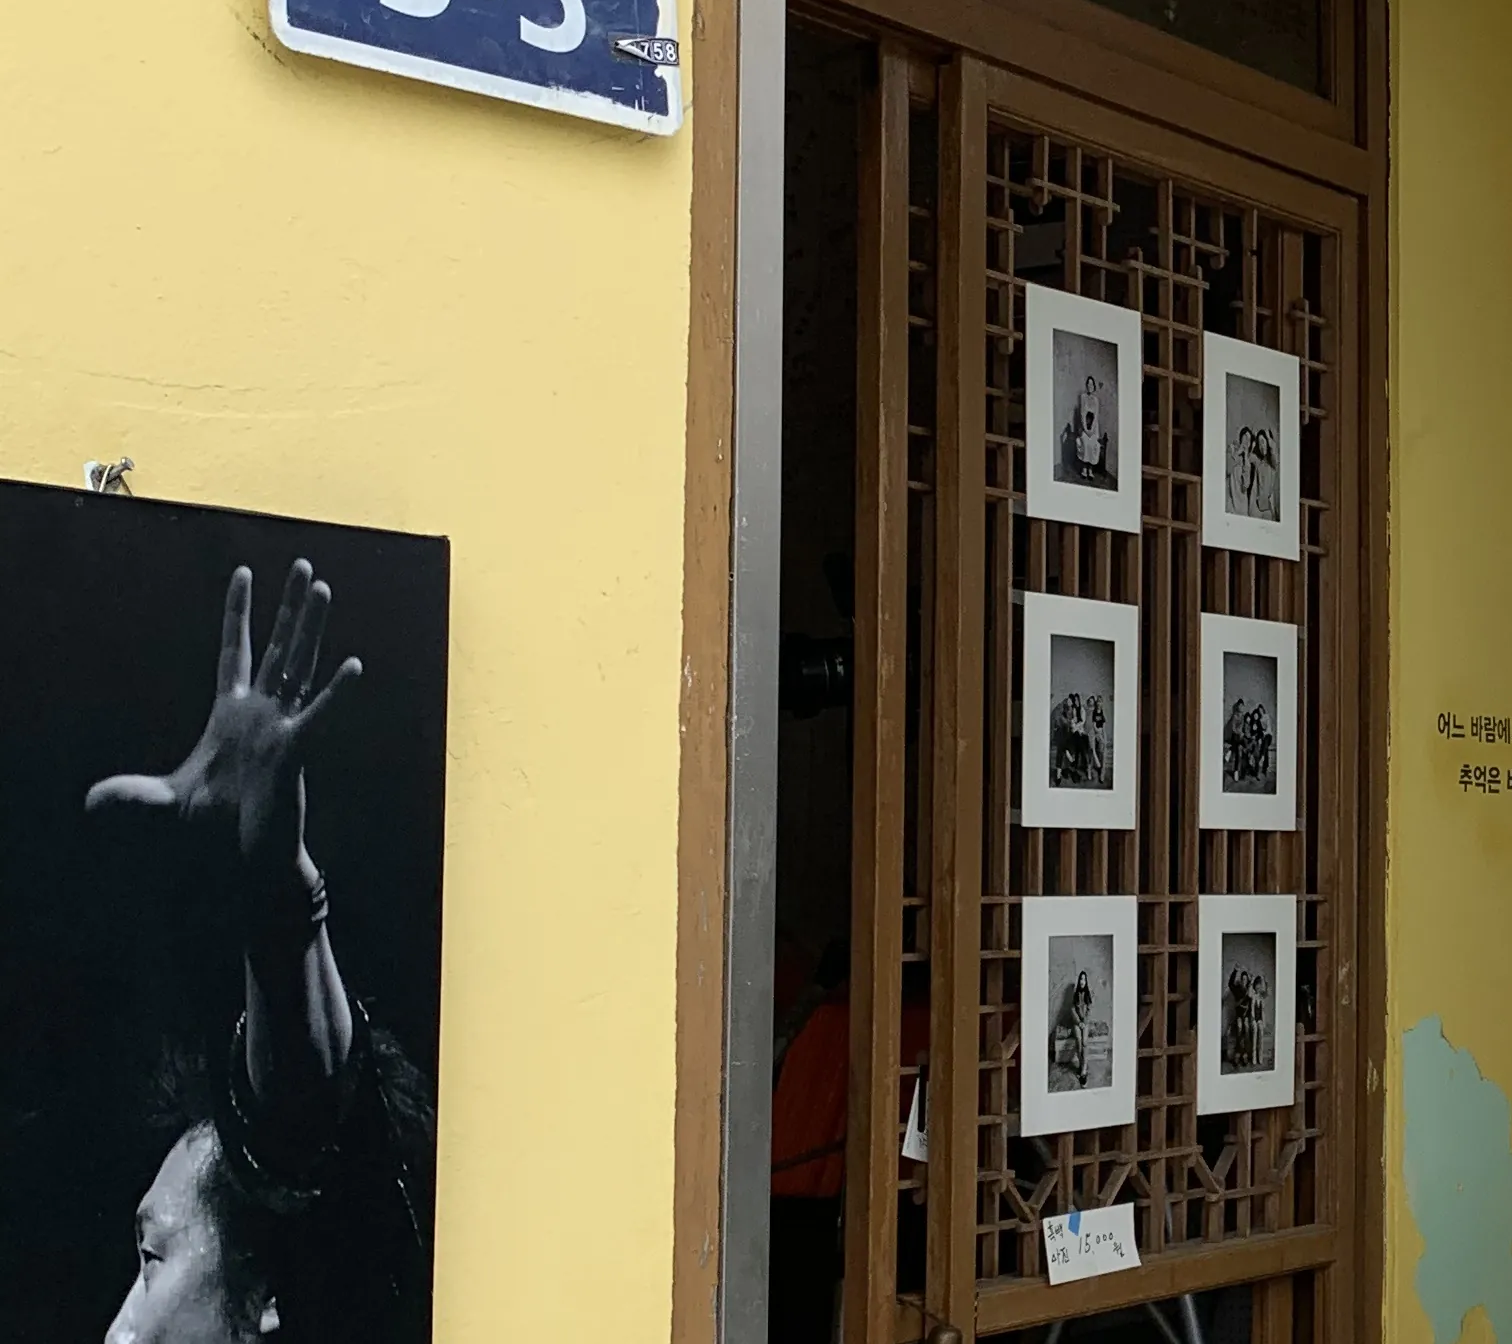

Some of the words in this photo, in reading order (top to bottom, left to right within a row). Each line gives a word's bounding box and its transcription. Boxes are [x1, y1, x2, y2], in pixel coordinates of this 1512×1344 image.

[1437, 711, 1465, 740] 어느
[1470, 715, 1511, 744] 바람에
[1459, 763, 1501, 794] 추억은
